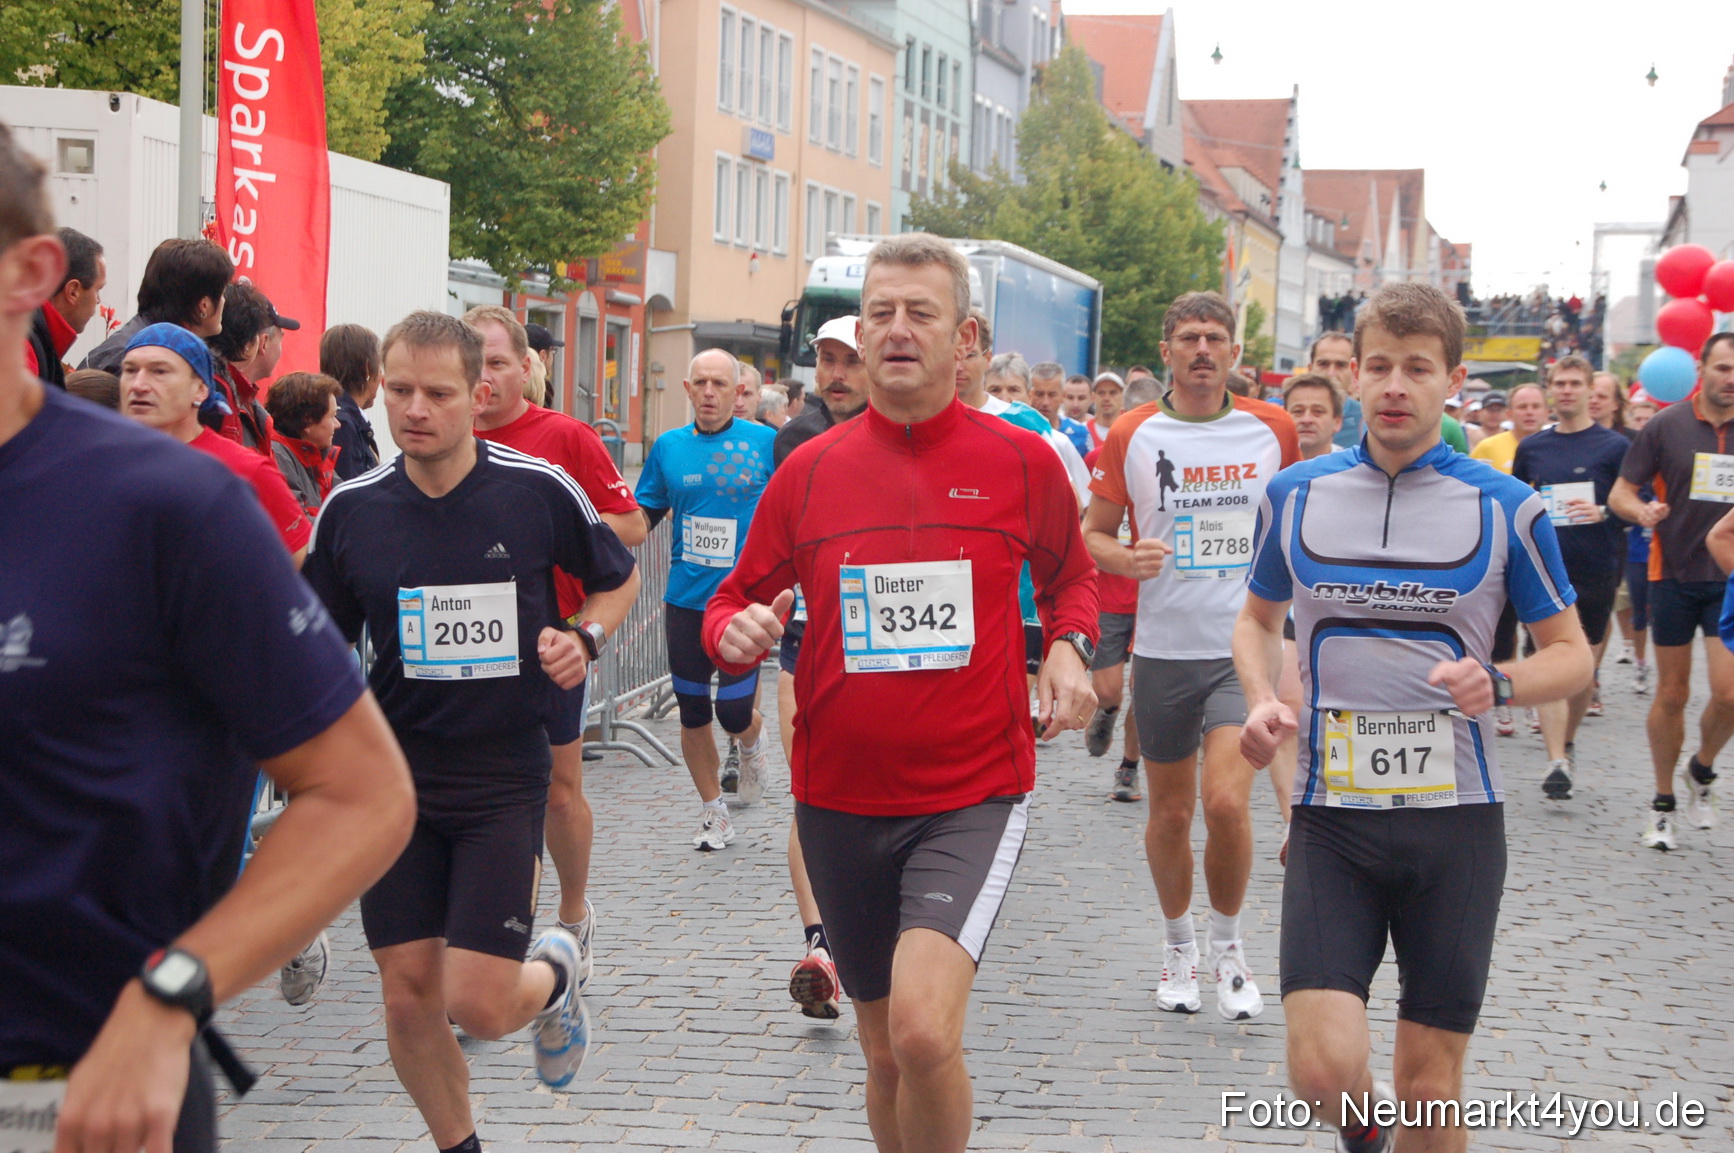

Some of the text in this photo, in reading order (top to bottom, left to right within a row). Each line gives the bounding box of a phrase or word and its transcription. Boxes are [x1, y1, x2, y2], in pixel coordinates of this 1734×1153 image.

[1183, 463, 1258, 483] MERZ
[1180, 478, 1242, 493] Reisen
[1173, 495, 1248, 508] TEAM 2008
[694, 521, 727, 534] Wolfgang
[1200, 520, 1223, 532] Alois
[695, 535, 729, 550] 2097
[1181, 539, 1186, 548] A
[1201, 537, 1249, 556] 2788
[875, 576, 924, 594] Dieter
[1313, 580, 1459, 605] mybike
[431, 595, 471, 612] Anton
[1372, 603, 1450, 614] RACING
[850, 605, 858, 619] B
[880, 603, 957, 633] 3342
[407, 621, 414, 634] A
[434, 619, 504, 646] 2030
[923, 651, 969, 662] PFLEIDERER
[473, 661, 517, 672] PFLEIDERER
[1357, 713, 1436, 735] Bernhard
[1330, 746, 1338, 760] A
[1371, 746, 1432, 776] 617
[1406, 790, 1455, 802] PFLEIDERER
